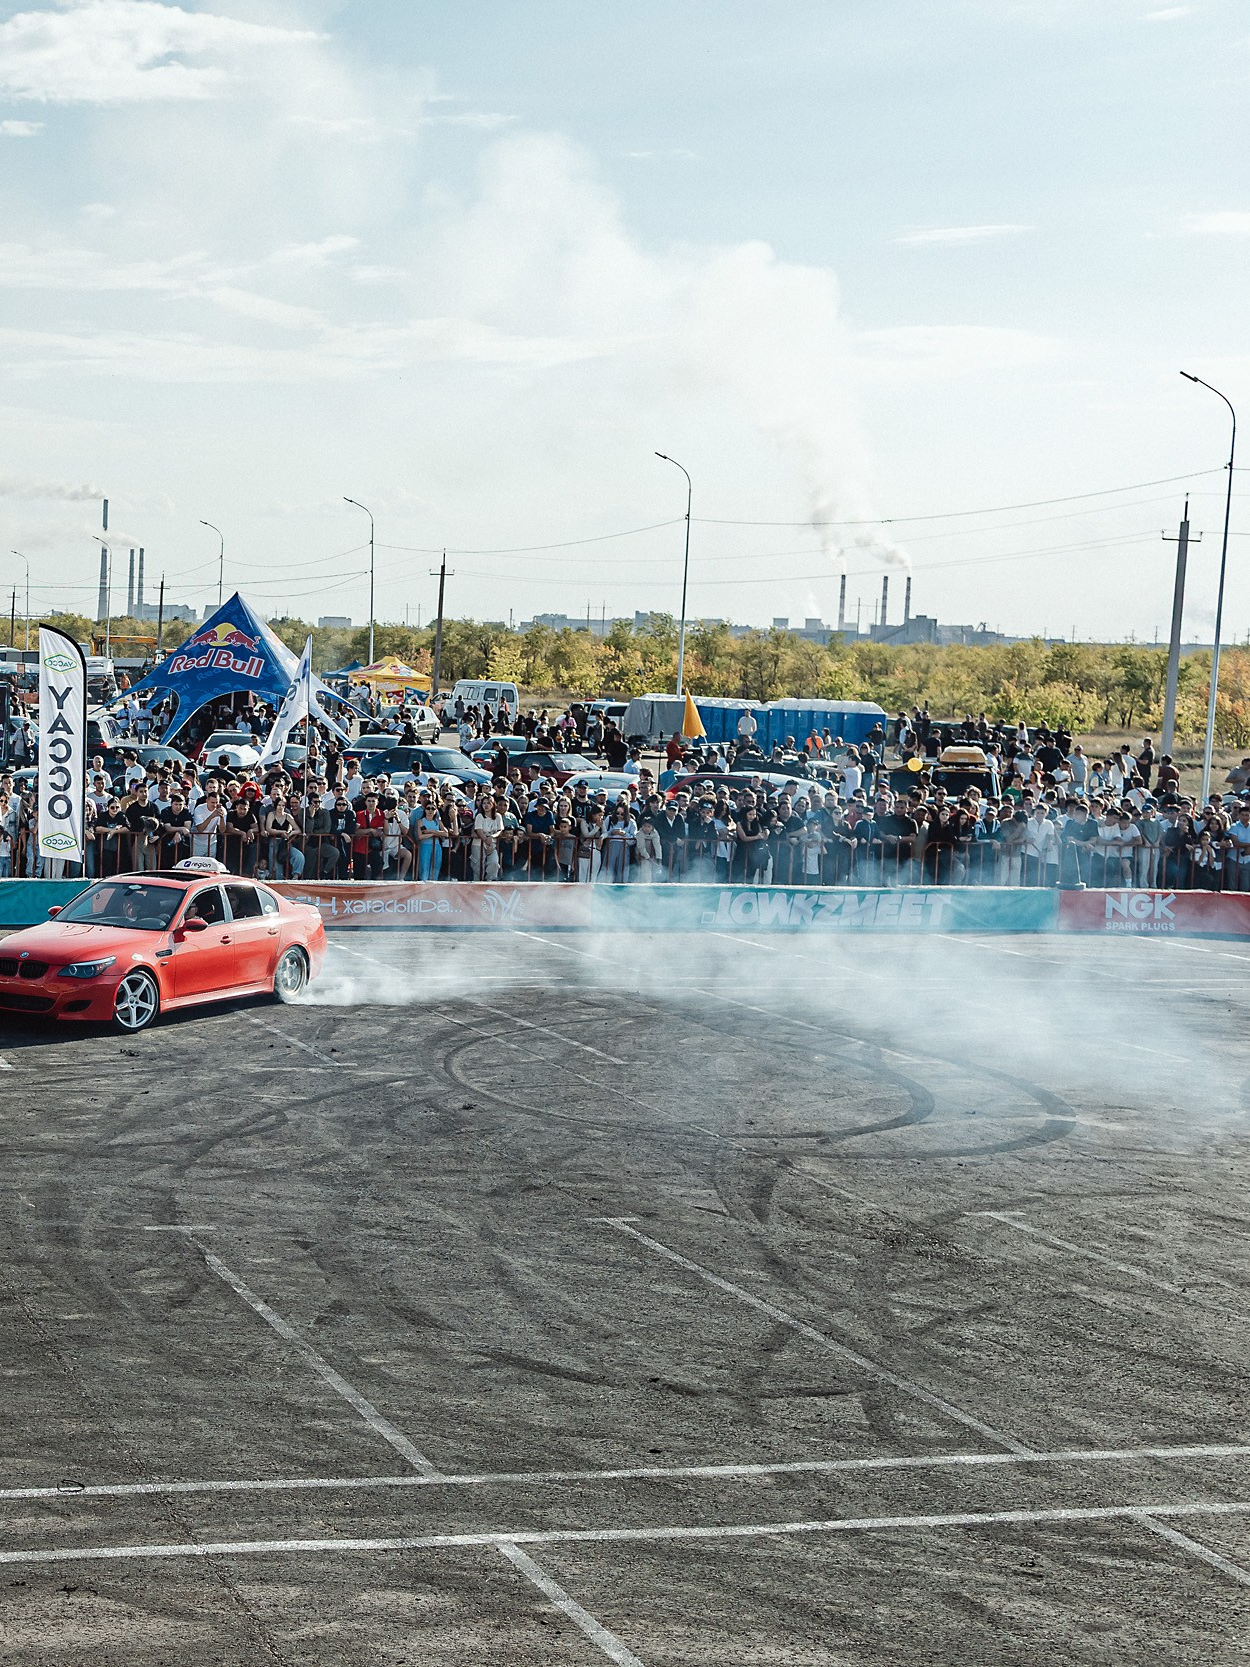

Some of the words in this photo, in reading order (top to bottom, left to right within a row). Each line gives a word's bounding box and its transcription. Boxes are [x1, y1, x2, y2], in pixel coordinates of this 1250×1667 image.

[168, 648, 216, 675] Red
[212, 648, 265, 678] Bull
[191, 861, 211, 869] region
[1105, 892, 1177, 920] NGK
[1105, 922, 1139, 931] SPARK
[1141, 922, 1175, 931] PLUGS
